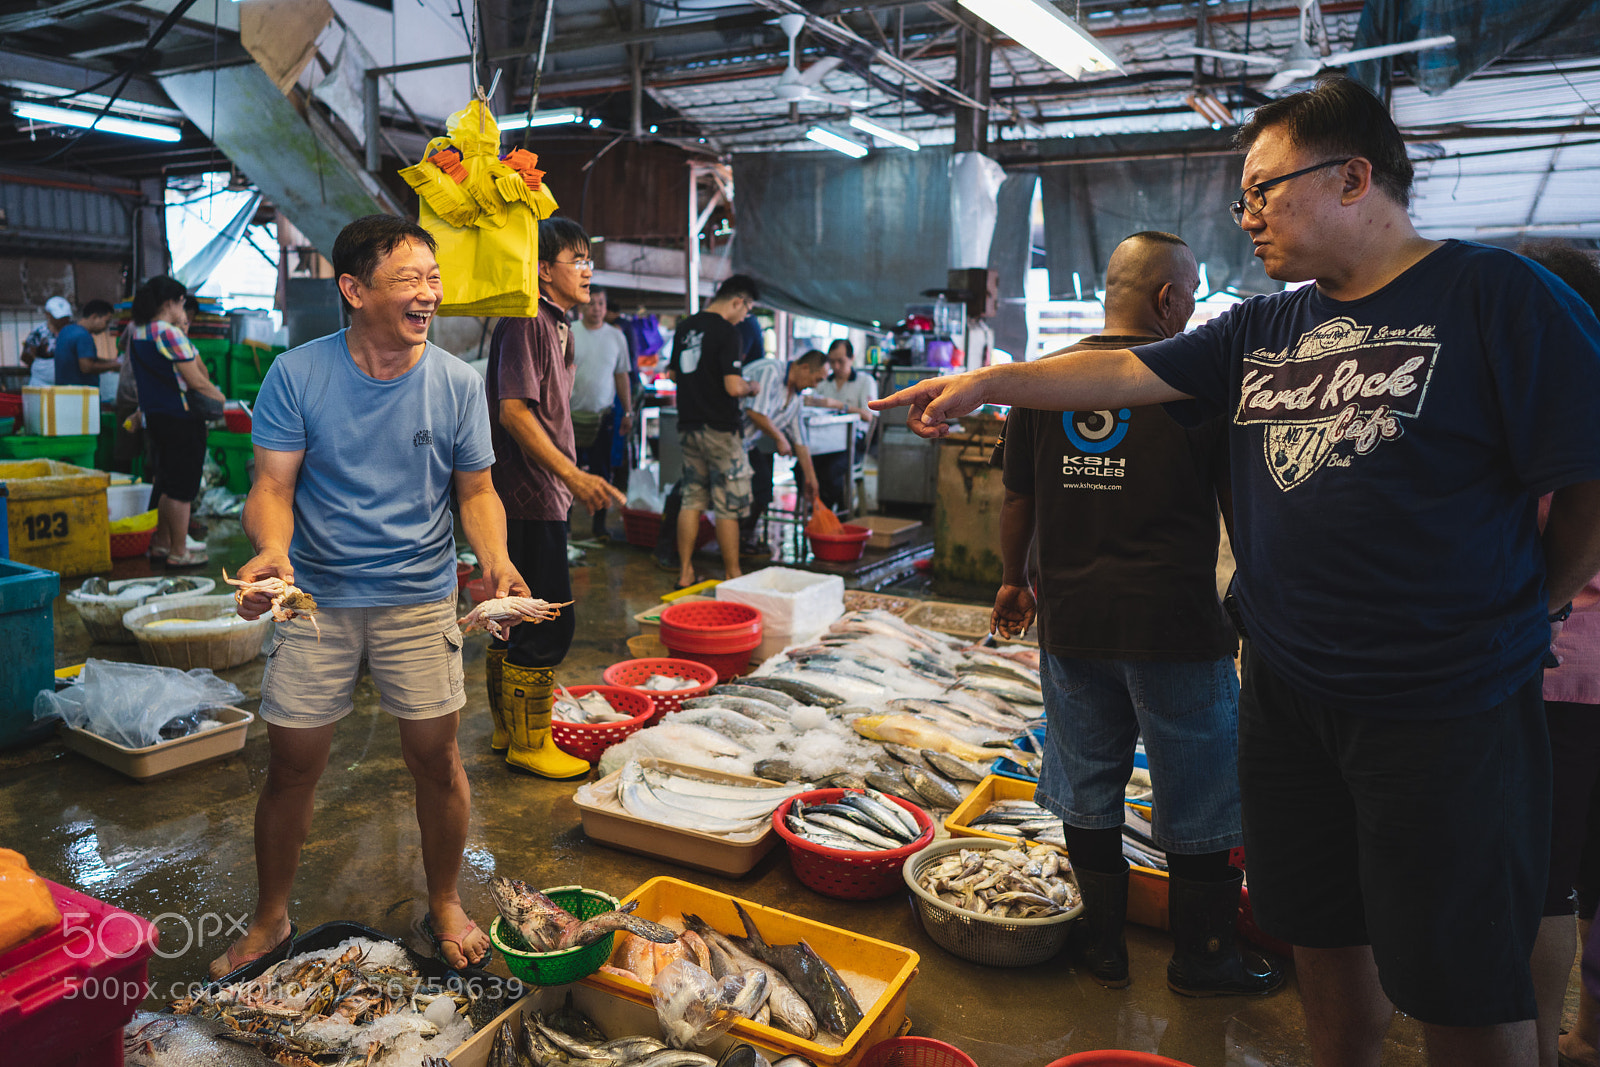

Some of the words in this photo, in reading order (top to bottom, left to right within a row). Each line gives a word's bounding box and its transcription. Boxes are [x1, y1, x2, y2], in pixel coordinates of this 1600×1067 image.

[1241, 369, 1324, 414] Hard
[1320, 355, 1425, 410] Rock
[1327, 403, 1401, 454] Cafe
[1295, 426, 1327, 463] 71
[1062, 455, 1126, 468] KSH
[1326, 452, 1355, 468] Bali
[1062, 466, 1126, 478] CYCLES
[1062, 482, 1122, 491] www.kshcycles.com
[23, 511, 69, 542] 123
